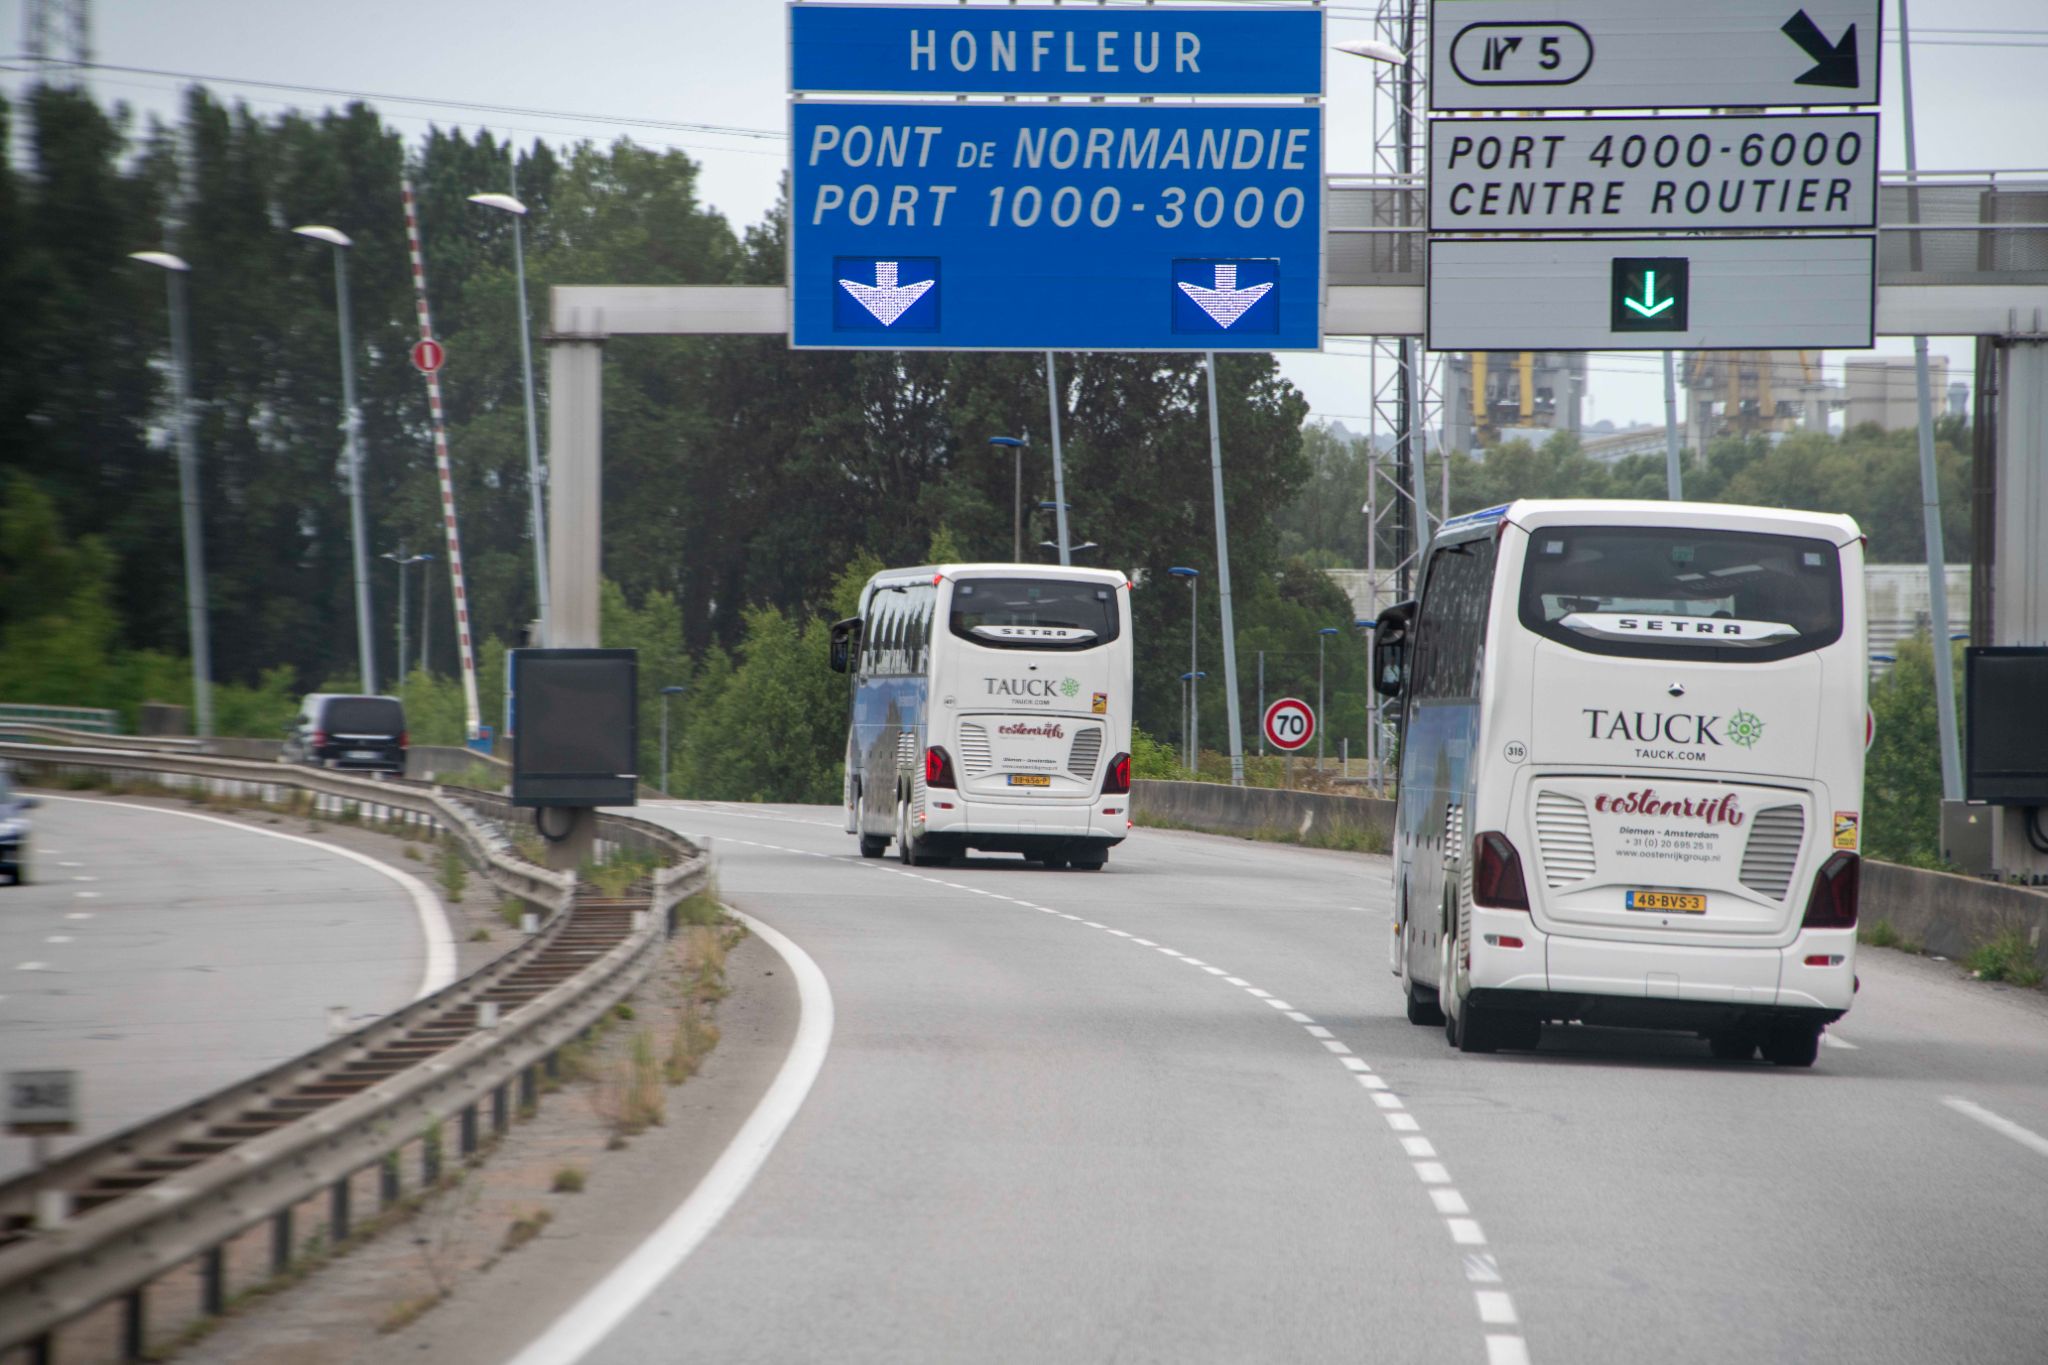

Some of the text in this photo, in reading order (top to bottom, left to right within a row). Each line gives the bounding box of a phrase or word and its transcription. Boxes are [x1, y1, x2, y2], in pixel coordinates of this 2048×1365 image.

[910, 30, 1201, 73] HONFLEUR
[1538, 37, 1561, 70] 5
[809, 125, 1310, 170] PONT DE NORMANDIE
[1447, 132, 1862, 170] PORT 4000-6000
[813, 184, 957, 227] PORT
[1449, 178, 1852, 216] CENTRE ROUTIER
[1002, 628, 1067, 637] SETRA
[1619, 619, 1741, 635] SETRA
[983, 677, 1058, 697] TAUCK
[1277, 715, 1304, 735] 70
[1582, 708, 1723, 746] TAUCK
[1508, 746, 1524, 757] 315
[1635, 749, 1706, 761] TAUCK.COM
[1619, 826, 1655, 836] Diemen
[1664, 829, 1720, 839] Amsterdam
[1661, 840, 1672, 849] 20
[1638, 894, 1700, 909] 48-BVS-3
